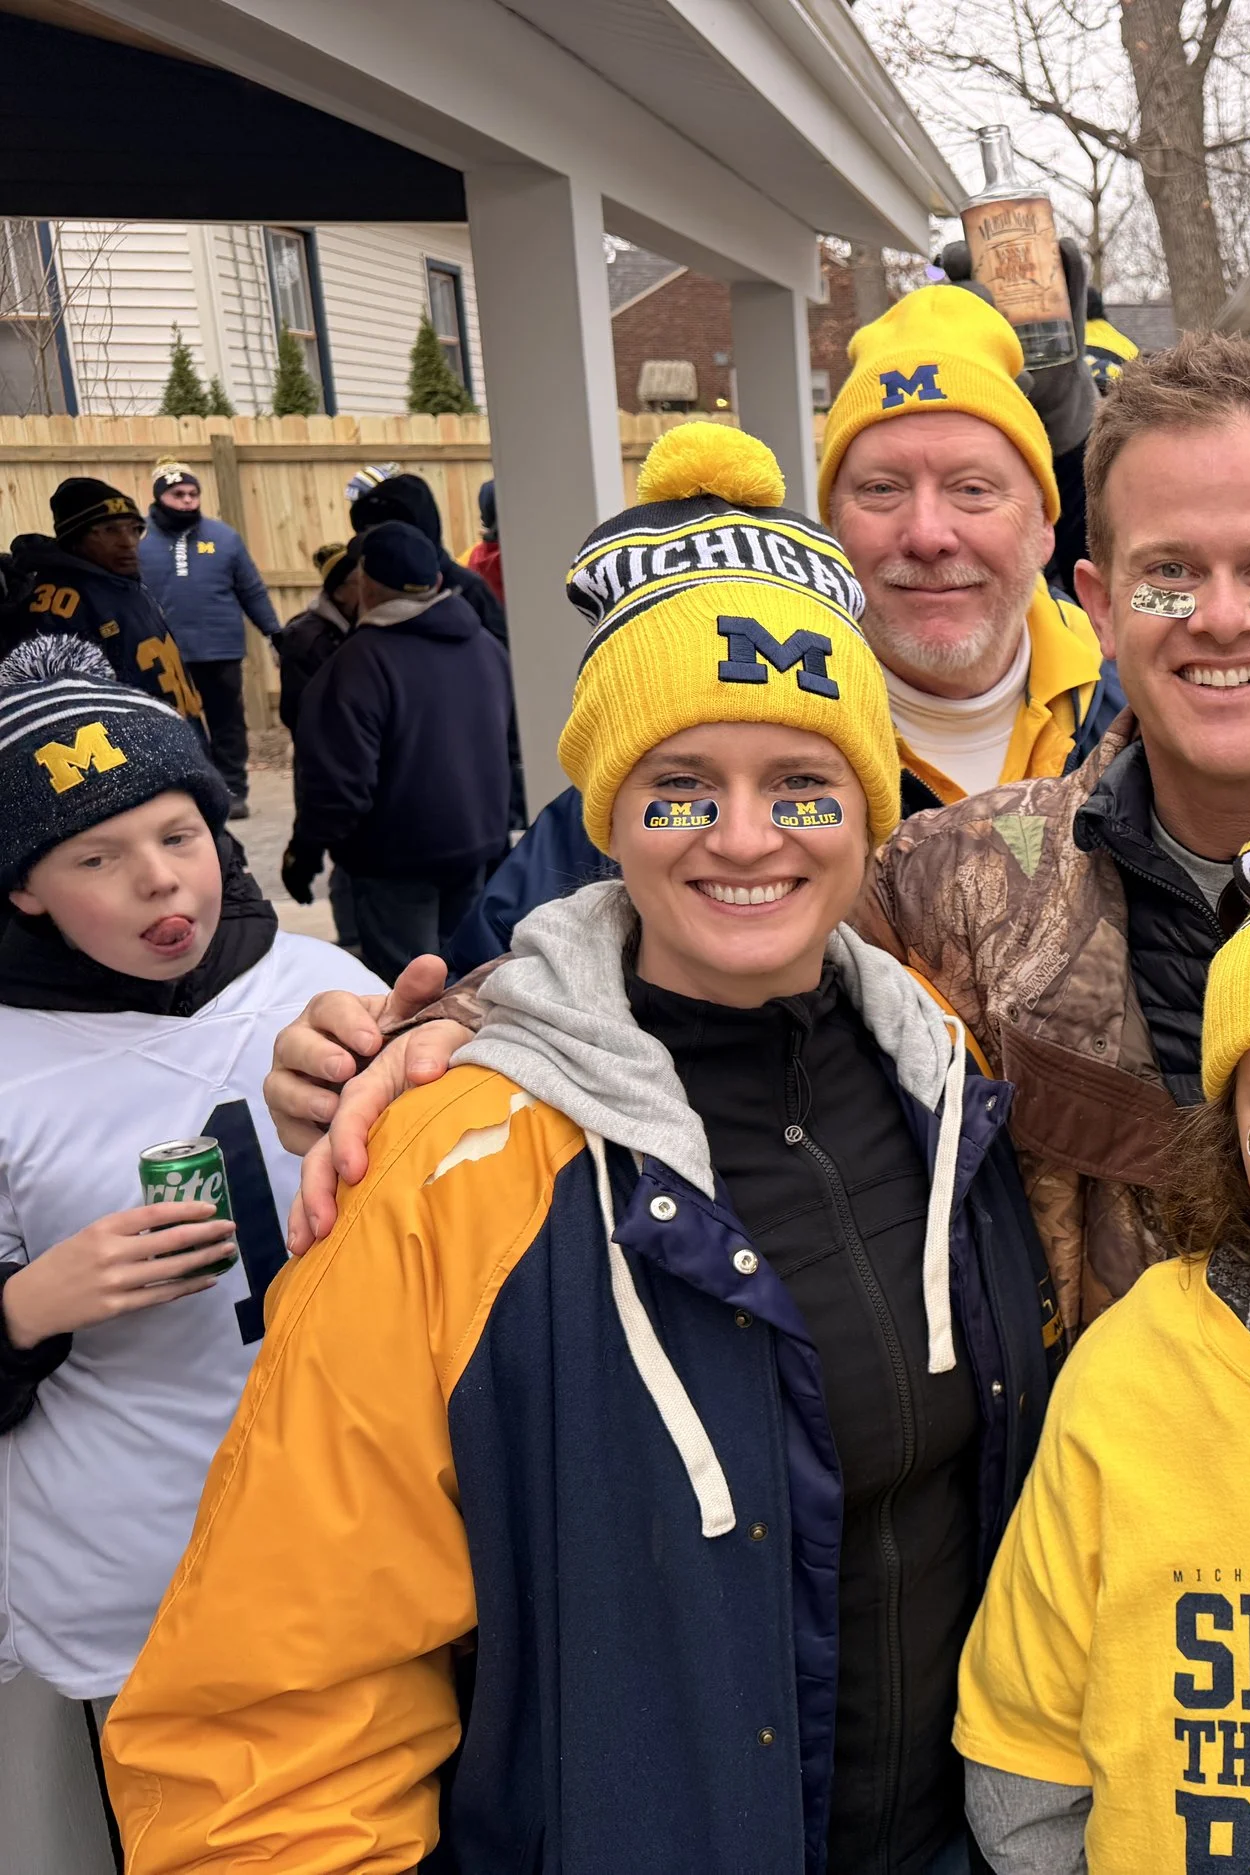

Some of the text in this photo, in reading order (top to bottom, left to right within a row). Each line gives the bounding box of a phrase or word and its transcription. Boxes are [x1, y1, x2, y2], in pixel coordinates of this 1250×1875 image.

[880, 365, 947, 410] M
[104, 497, 129, 515] M
[197, 541, 216, 554] M
[29, 584, 80, 619] 30
[1147, 590, 1180, 611] M
[717, 615, 840, 700] M
[34, 721, 128, 794] M
[670, 802, 692, 816] M
[796, 801, 817, 815] M
[650, 815, 711, 827] GO BLUE
[780, 813, 838, 826] GO BLUE
[1018, 951, 1061, 1001] ADVANTAGE
[146, 1169, 223, 1206] rite
